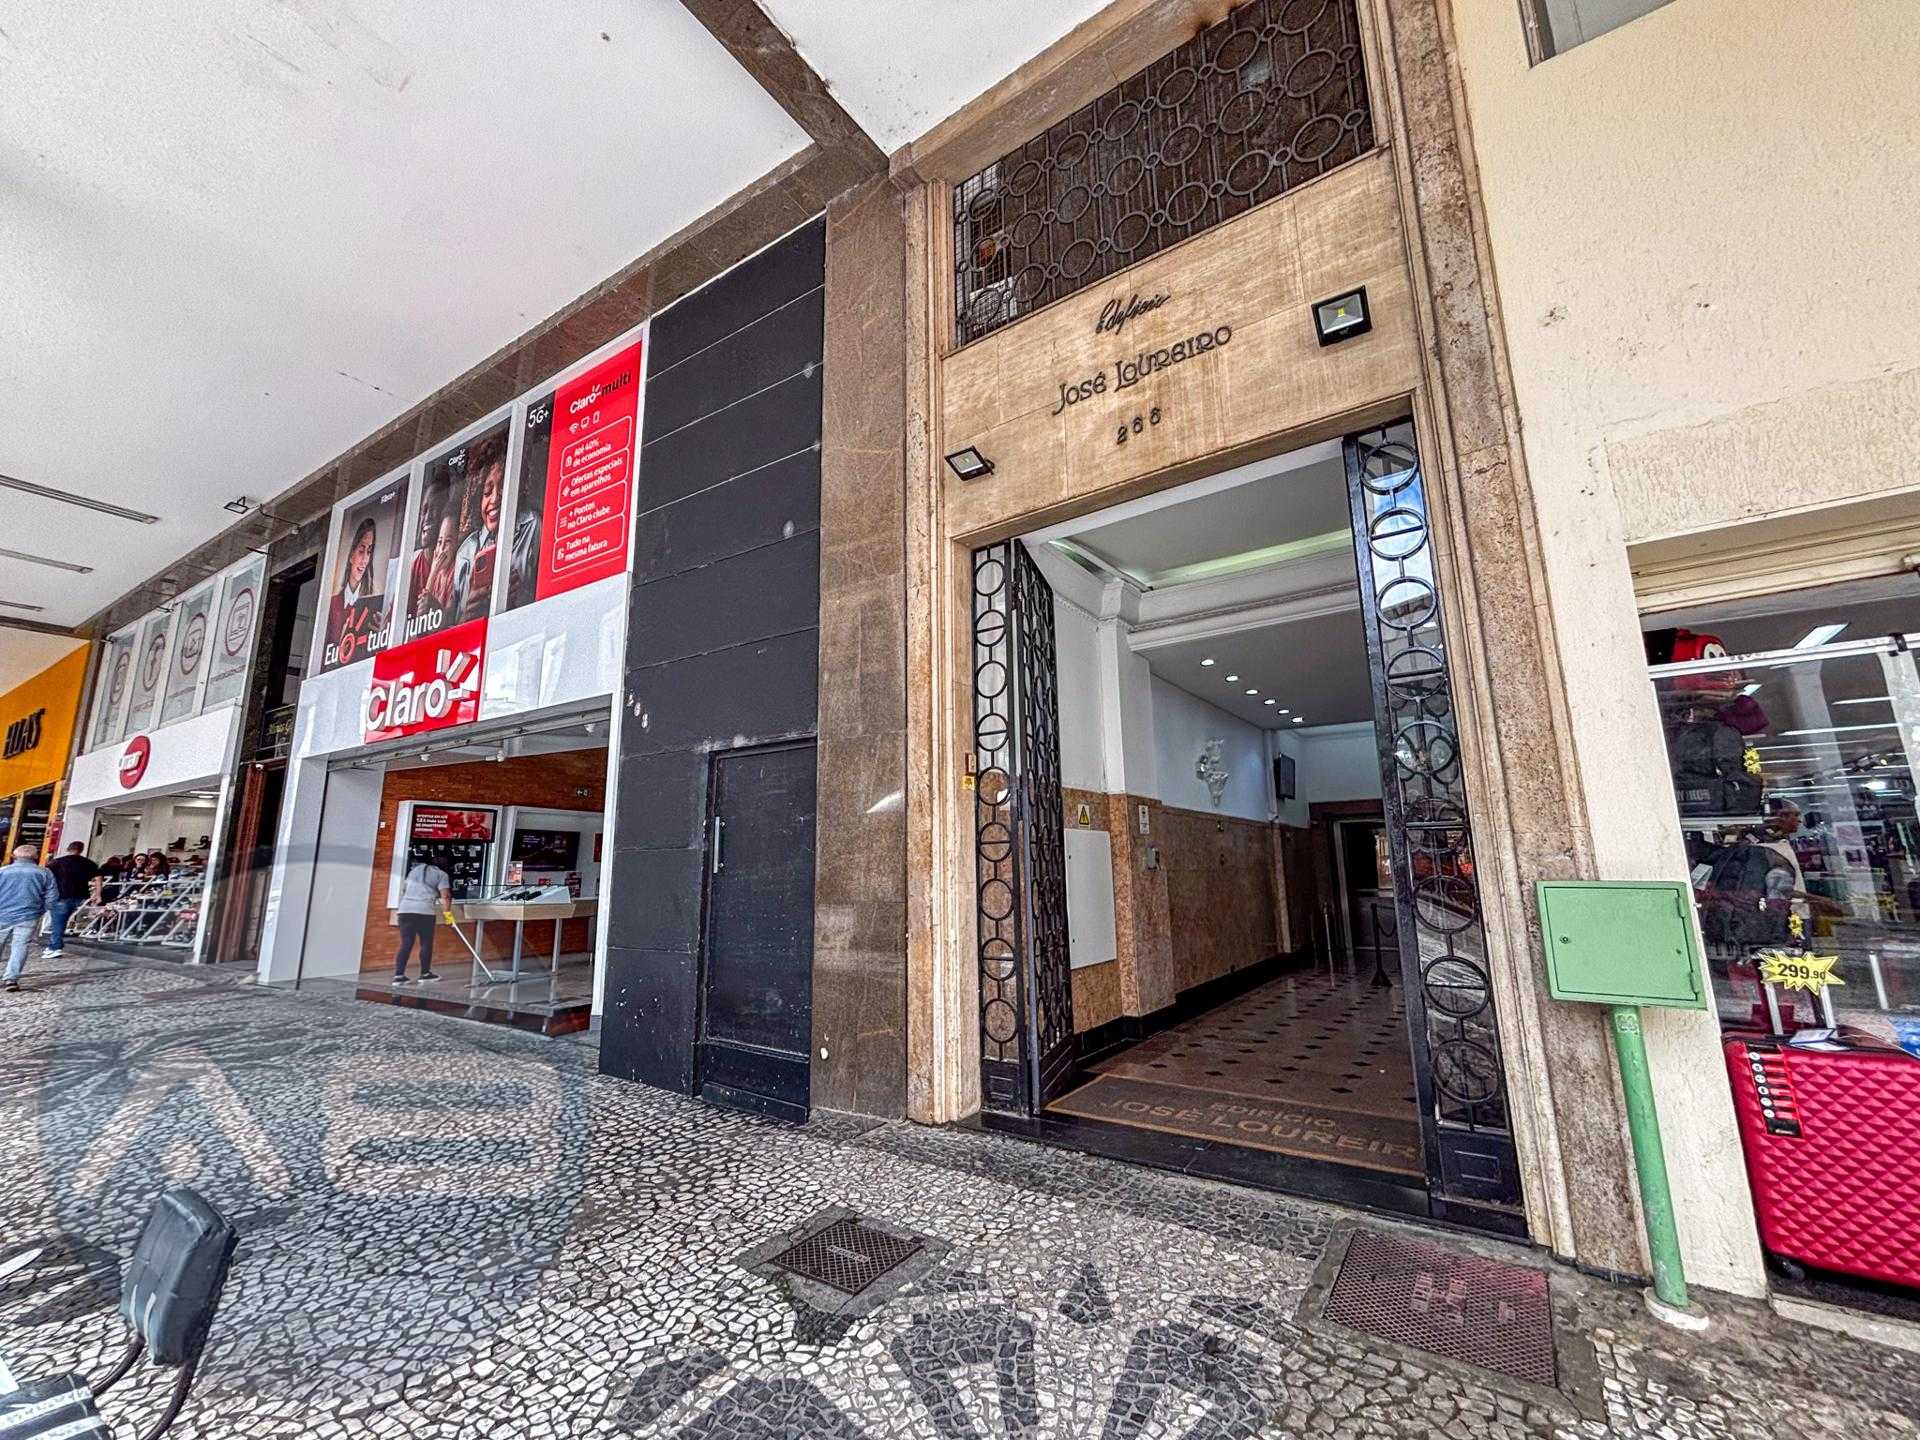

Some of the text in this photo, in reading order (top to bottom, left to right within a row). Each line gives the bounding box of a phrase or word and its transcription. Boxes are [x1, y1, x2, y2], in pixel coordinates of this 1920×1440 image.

[600, 370, 631, 397] multi
[404, 608, 443, 644] junto
[366, 668, 455, 731] Claro
[1209, 1110, 1420, 1160] LOUREIR
